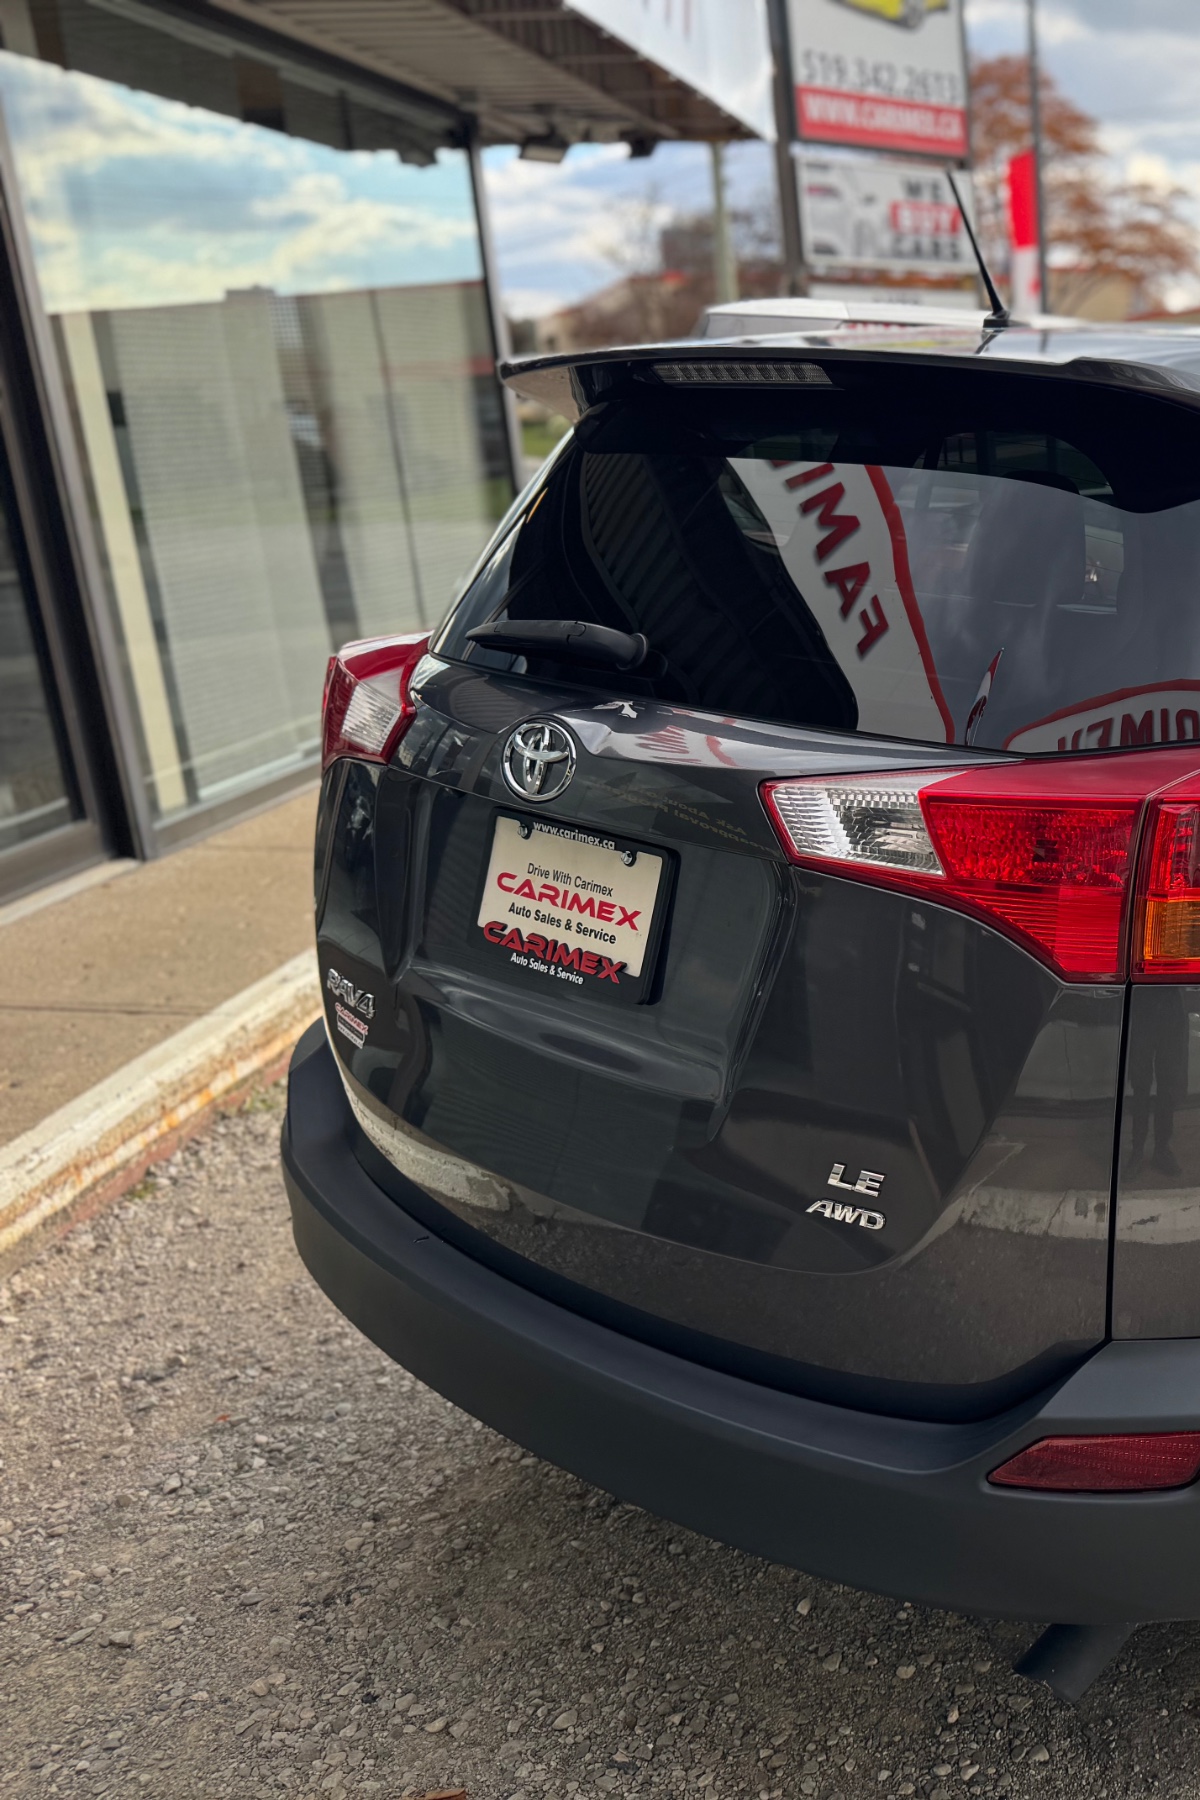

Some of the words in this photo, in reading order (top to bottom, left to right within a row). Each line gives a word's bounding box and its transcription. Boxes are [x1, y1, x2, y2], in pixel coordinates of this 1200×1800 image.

[905, 179, 940, 199] WE
[900, 206, 953, 235] BUY
[533, 821, 616, 850] www.carimex.ca
[527, 862, 550, 879] Drive
[552, 869, 573, 886] With
[574, 876, 614, 897] Carimex
[497, 871, 642, 931] CARIMEX
[508, 902, 532, 919] Auto
[533, 909, 562, 929] Sales
[564, 919, 573, 932] &
[575, 922, 617, 945] Service
[483, 921, 626, 984] CARIMEX
[510, 952, 528, 967] Auto
[528, 959, 549, 974] Sales
[549, 965, 556, 976] &
[557, 967, 584, 985] Service
[326, 968, 375, 1019] RAV4
[827, 1163, 885, 1198] LE
[805, 1199, 886, 1230] AWD
